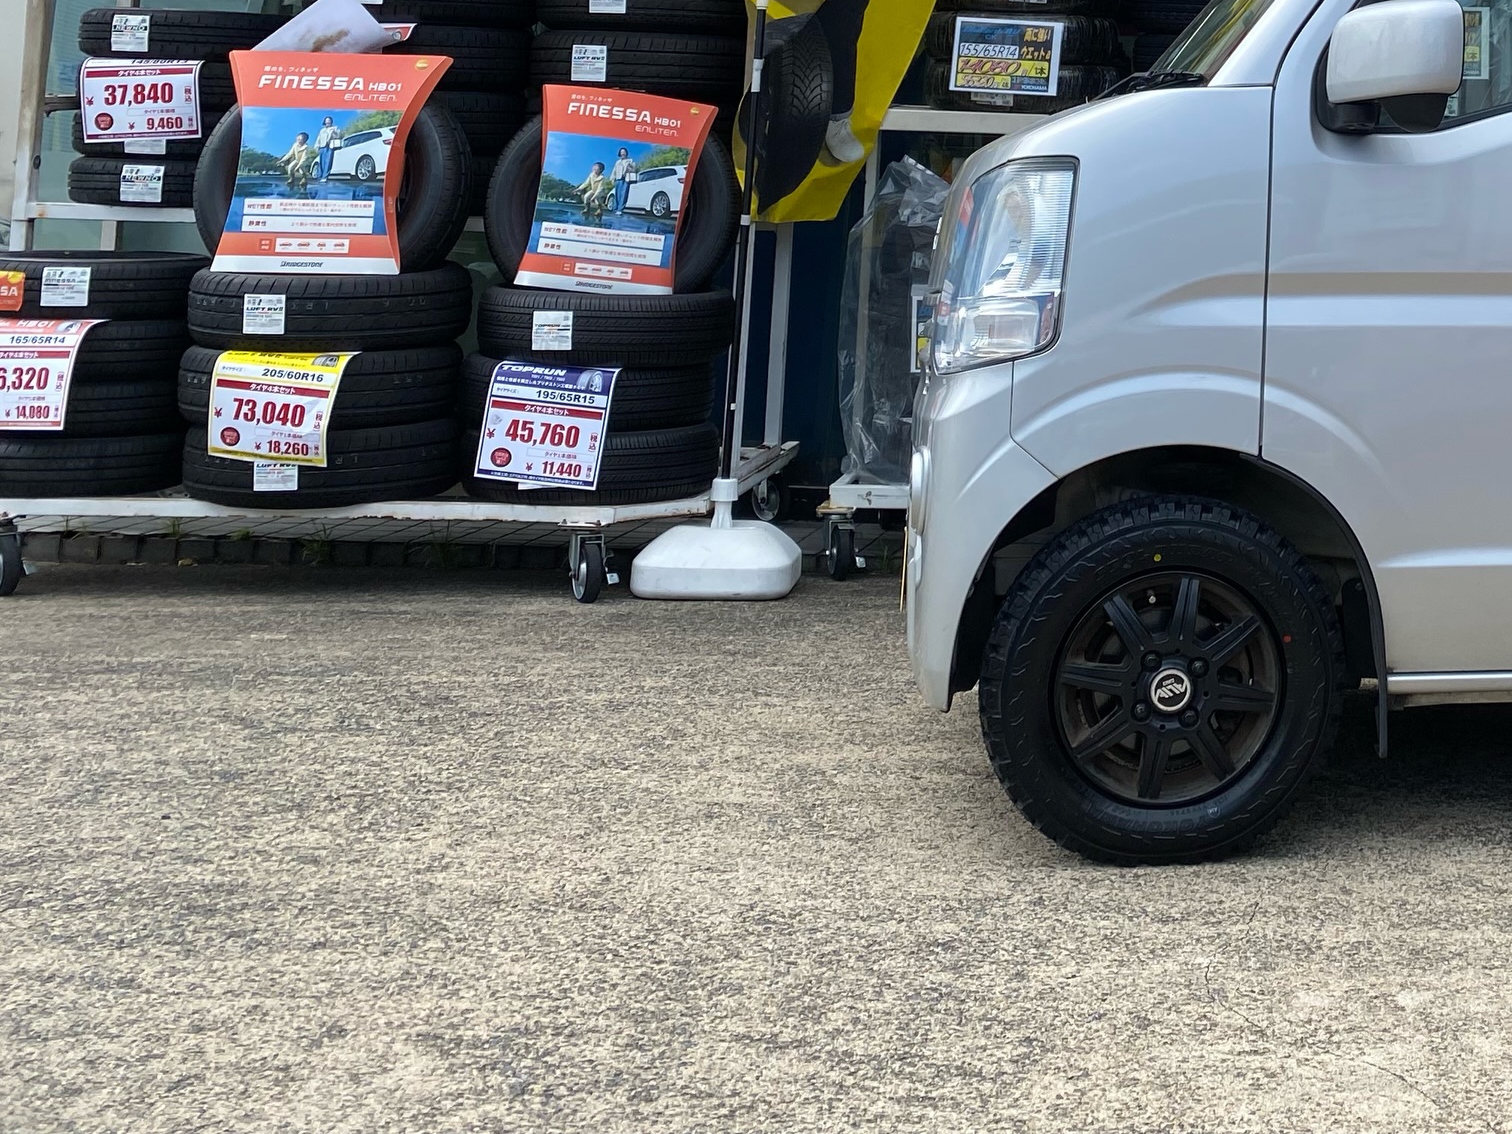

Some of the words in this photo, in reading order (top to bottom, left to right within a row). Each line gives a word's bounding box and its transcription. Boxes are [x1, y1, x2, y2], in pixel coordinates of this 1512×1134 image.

[960, 44, 1018, 58] 155/65R14
[258, 74, 365, 91] FINESSA
[368, 82, 403, 92] HB01
[104, 82, 174, 107] 37,840
[567, 102, 651, 123] FINESSA
[654, 116, 681, 128] HB01
[146, 116, 183, 131] 9,460
[575, 280, 613, 290] BRIDGESTONE
[10, 335, 66, 344] 165/65R14
[262, 368, 324, 383] 205/60R16
[502, 365, 567, 376] TOPRUN
[250, 383, 296, 395] タイヤ4本セット
[536, 389, 595, 405] 195/65R15
[15, 405, 50, 419] 14,080
[232, 397, 306, 428] 73,040
[524, 404, 570, 416] タイヤ4本セット
[505, 418, 580, 449] 45,760
[266, 439, 309, 457] 18,260
[542, 460, 582, 478] 11,440
